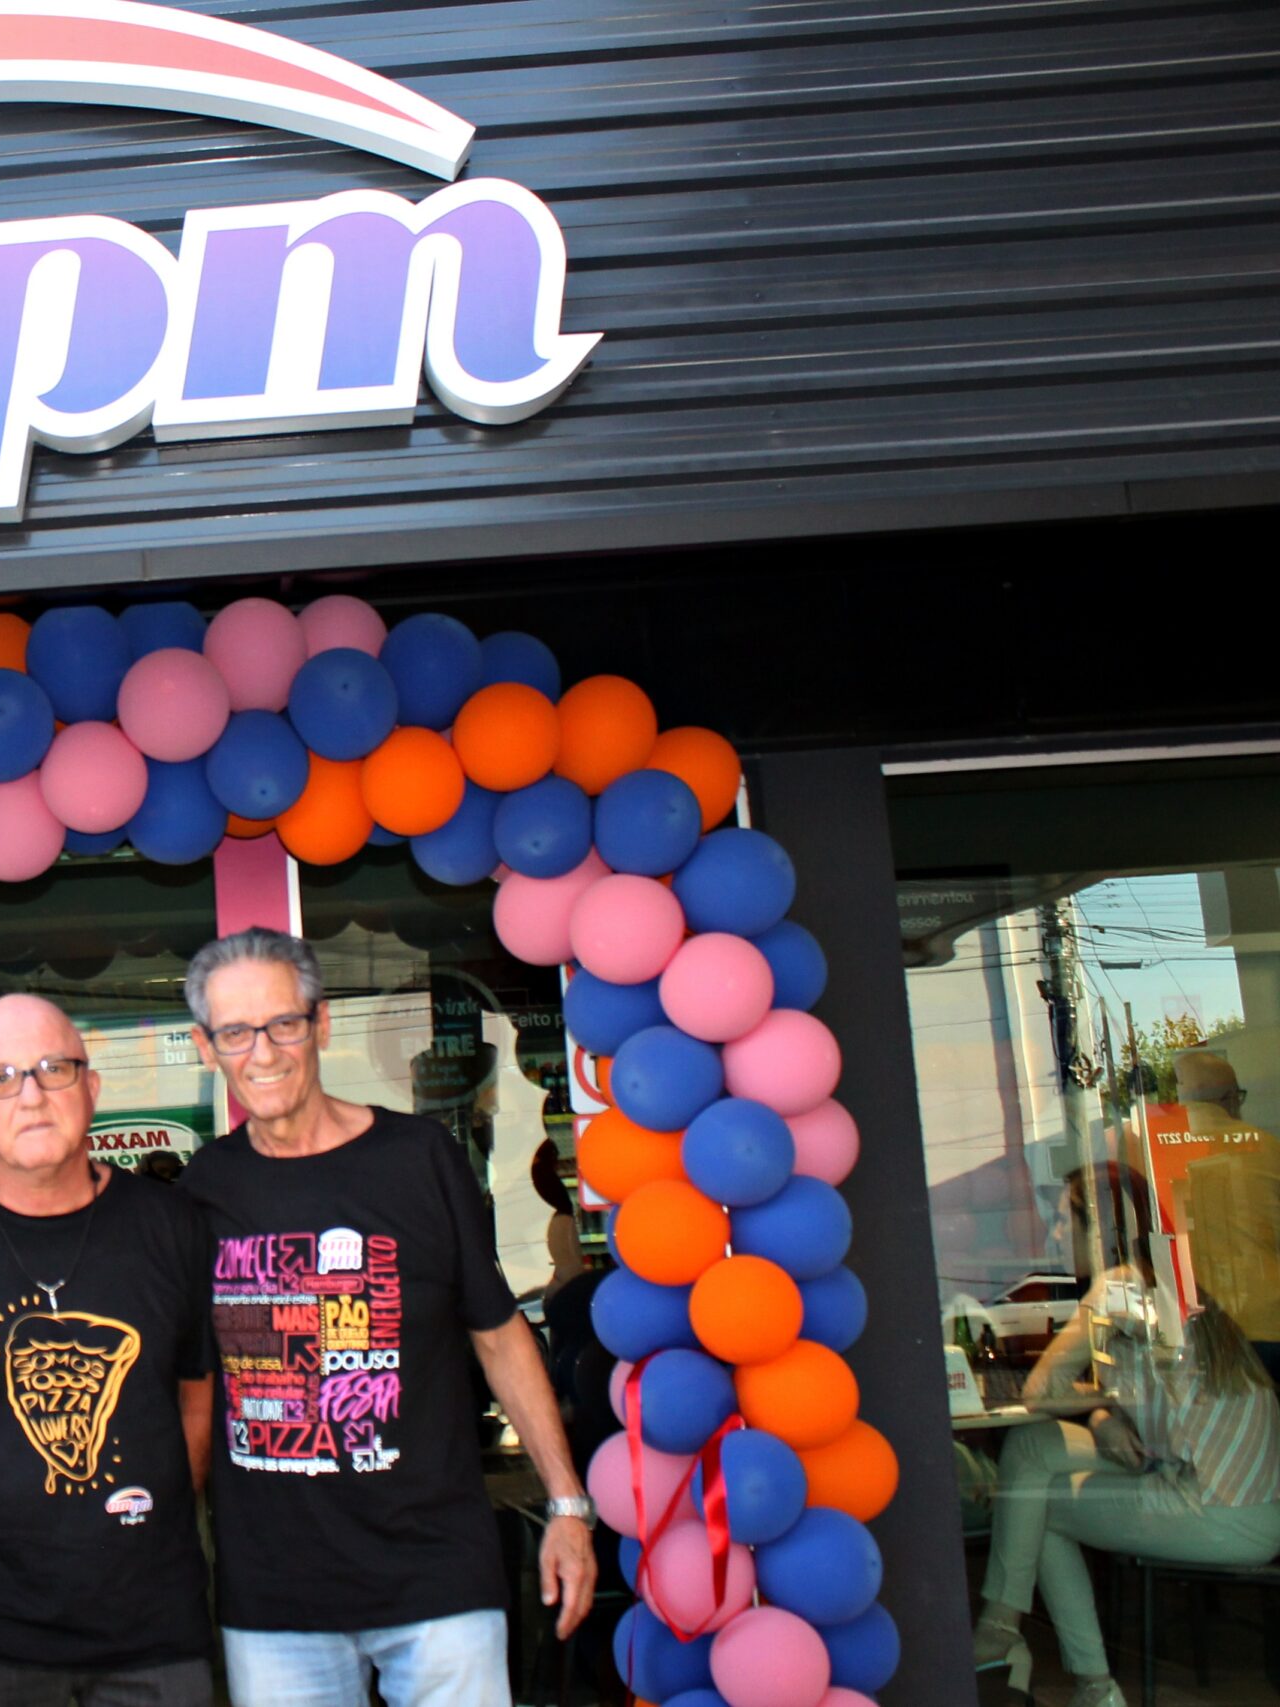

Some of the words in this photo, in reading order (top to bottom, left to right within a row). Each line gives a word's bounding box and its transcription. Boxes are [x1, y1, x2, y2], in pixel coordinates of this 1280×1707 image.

[400, 1033, 476, 1059] ENTRE
[363, 1234, 402, 1350] ENERGÉTICO
[272, 1305, 320, 1332] MAIS
[325, 1294, 370, 1328] PÃO
[12, 1353, 106, 1379] SOMOS
[324, 1349, 400, 1376] pausa
[16, 1370, 101, 1394] TODOS
[19, 1390, 93, 1414] PIZZA
[319, 1370, 403, 1423] FESTA
[30, 1413, 93, 1445] LOVERS
[249, 1422, 338, 1459] PIZZA
[279, 1456, 340, 1477] energias.
